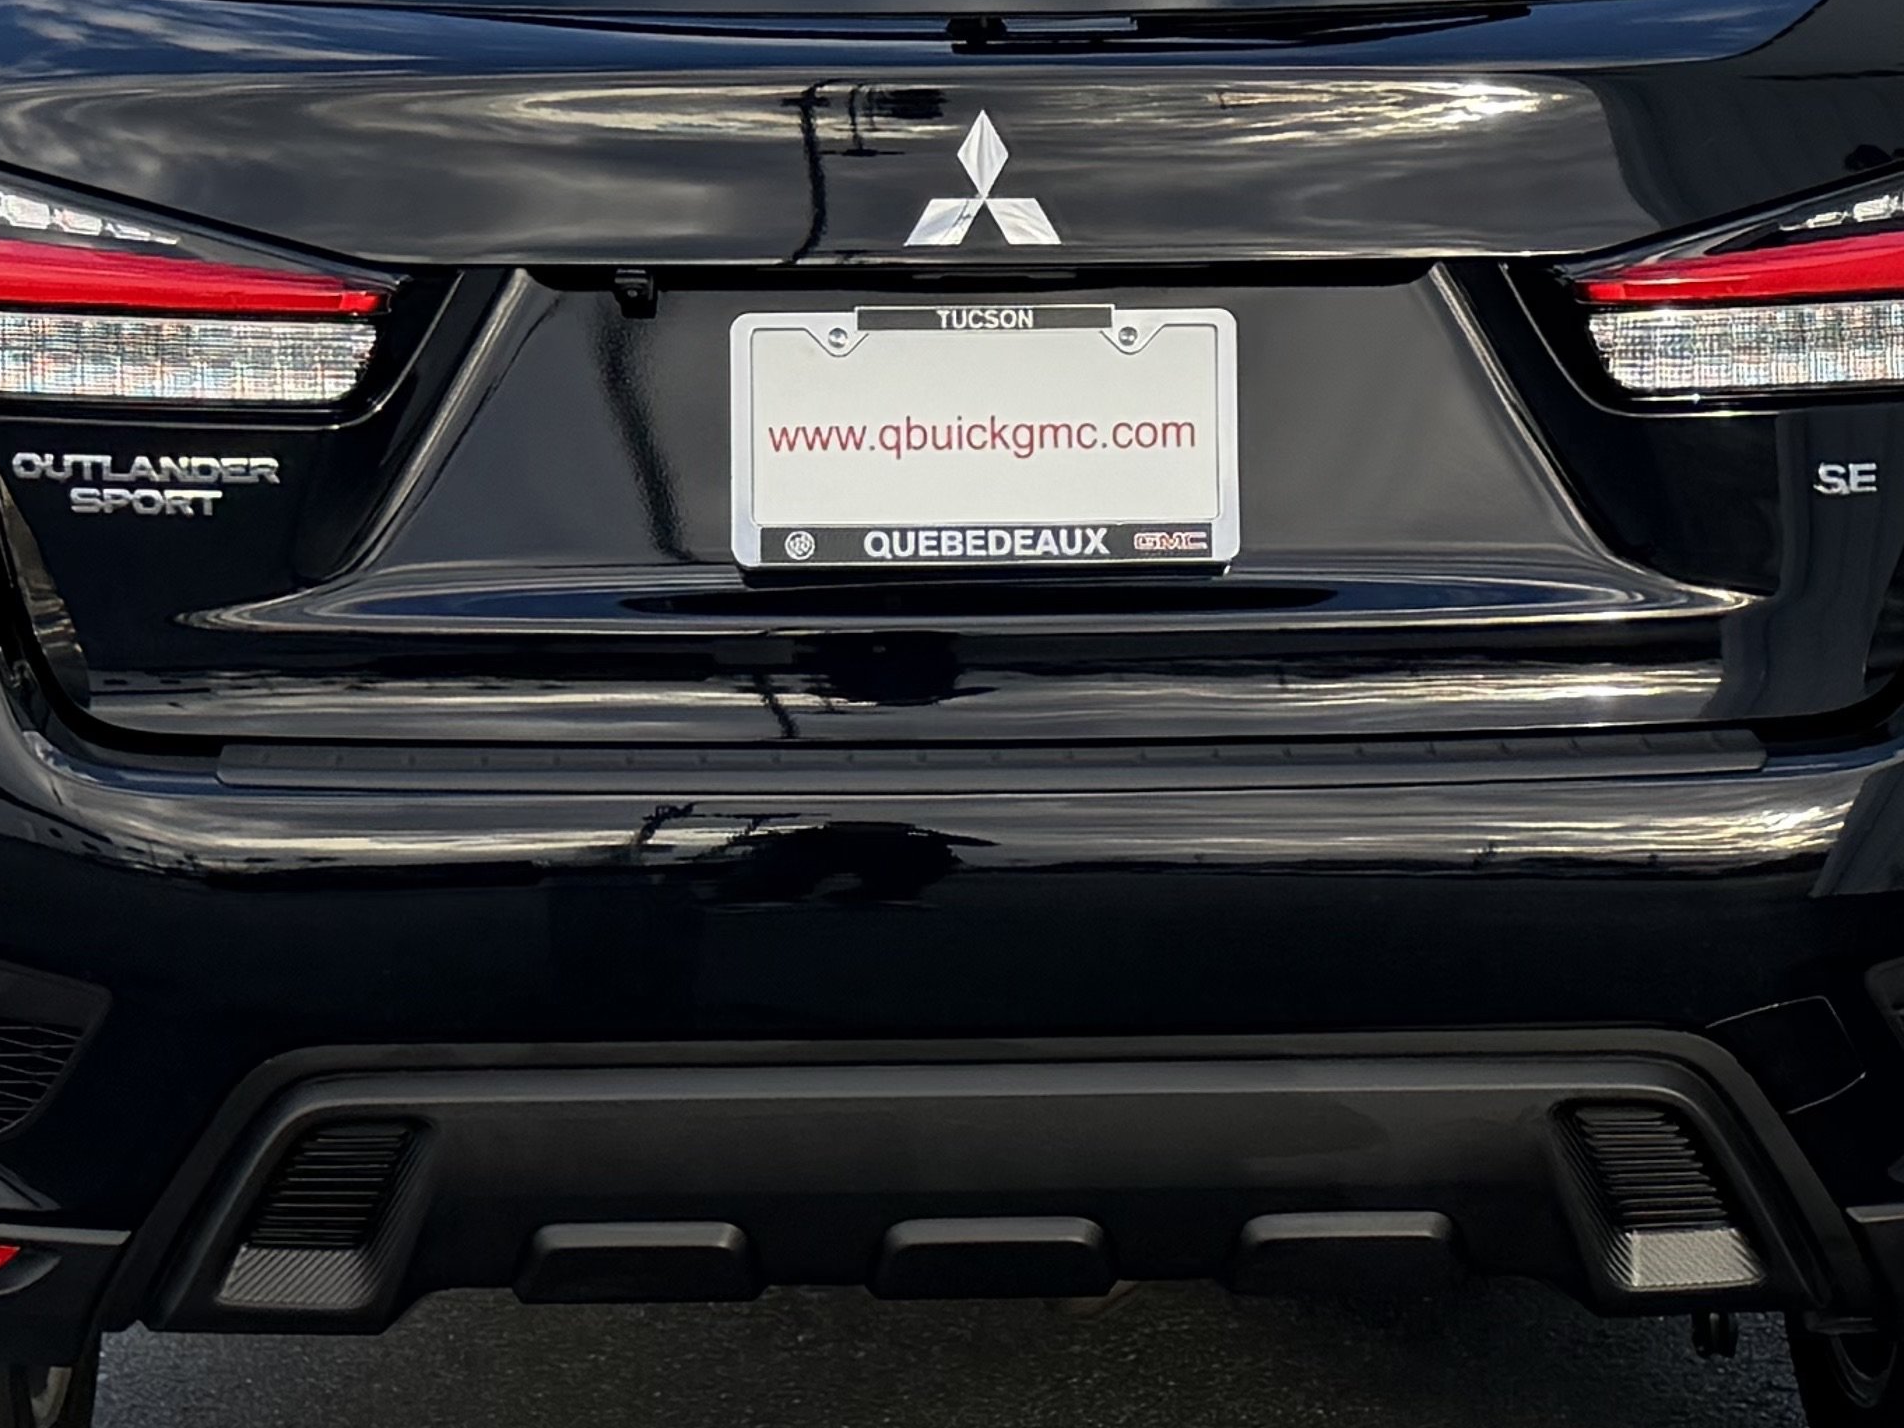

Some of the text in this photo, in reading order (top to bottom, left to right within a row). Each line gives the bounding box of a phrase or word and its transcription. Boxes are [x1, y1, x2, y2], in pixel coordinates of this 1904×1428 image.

[937, 309, 1034, 329] TUCSON
[768, 415, 1196, 460] www.qbuickgmc.com
[12, 452, 280, 483] OUTLANDER
[1813, 462, 1878, 495] SE
[70, 487, 223, 516] SPORT
[863, 527, 1207, 559] QUEBEDEAUX GMC
